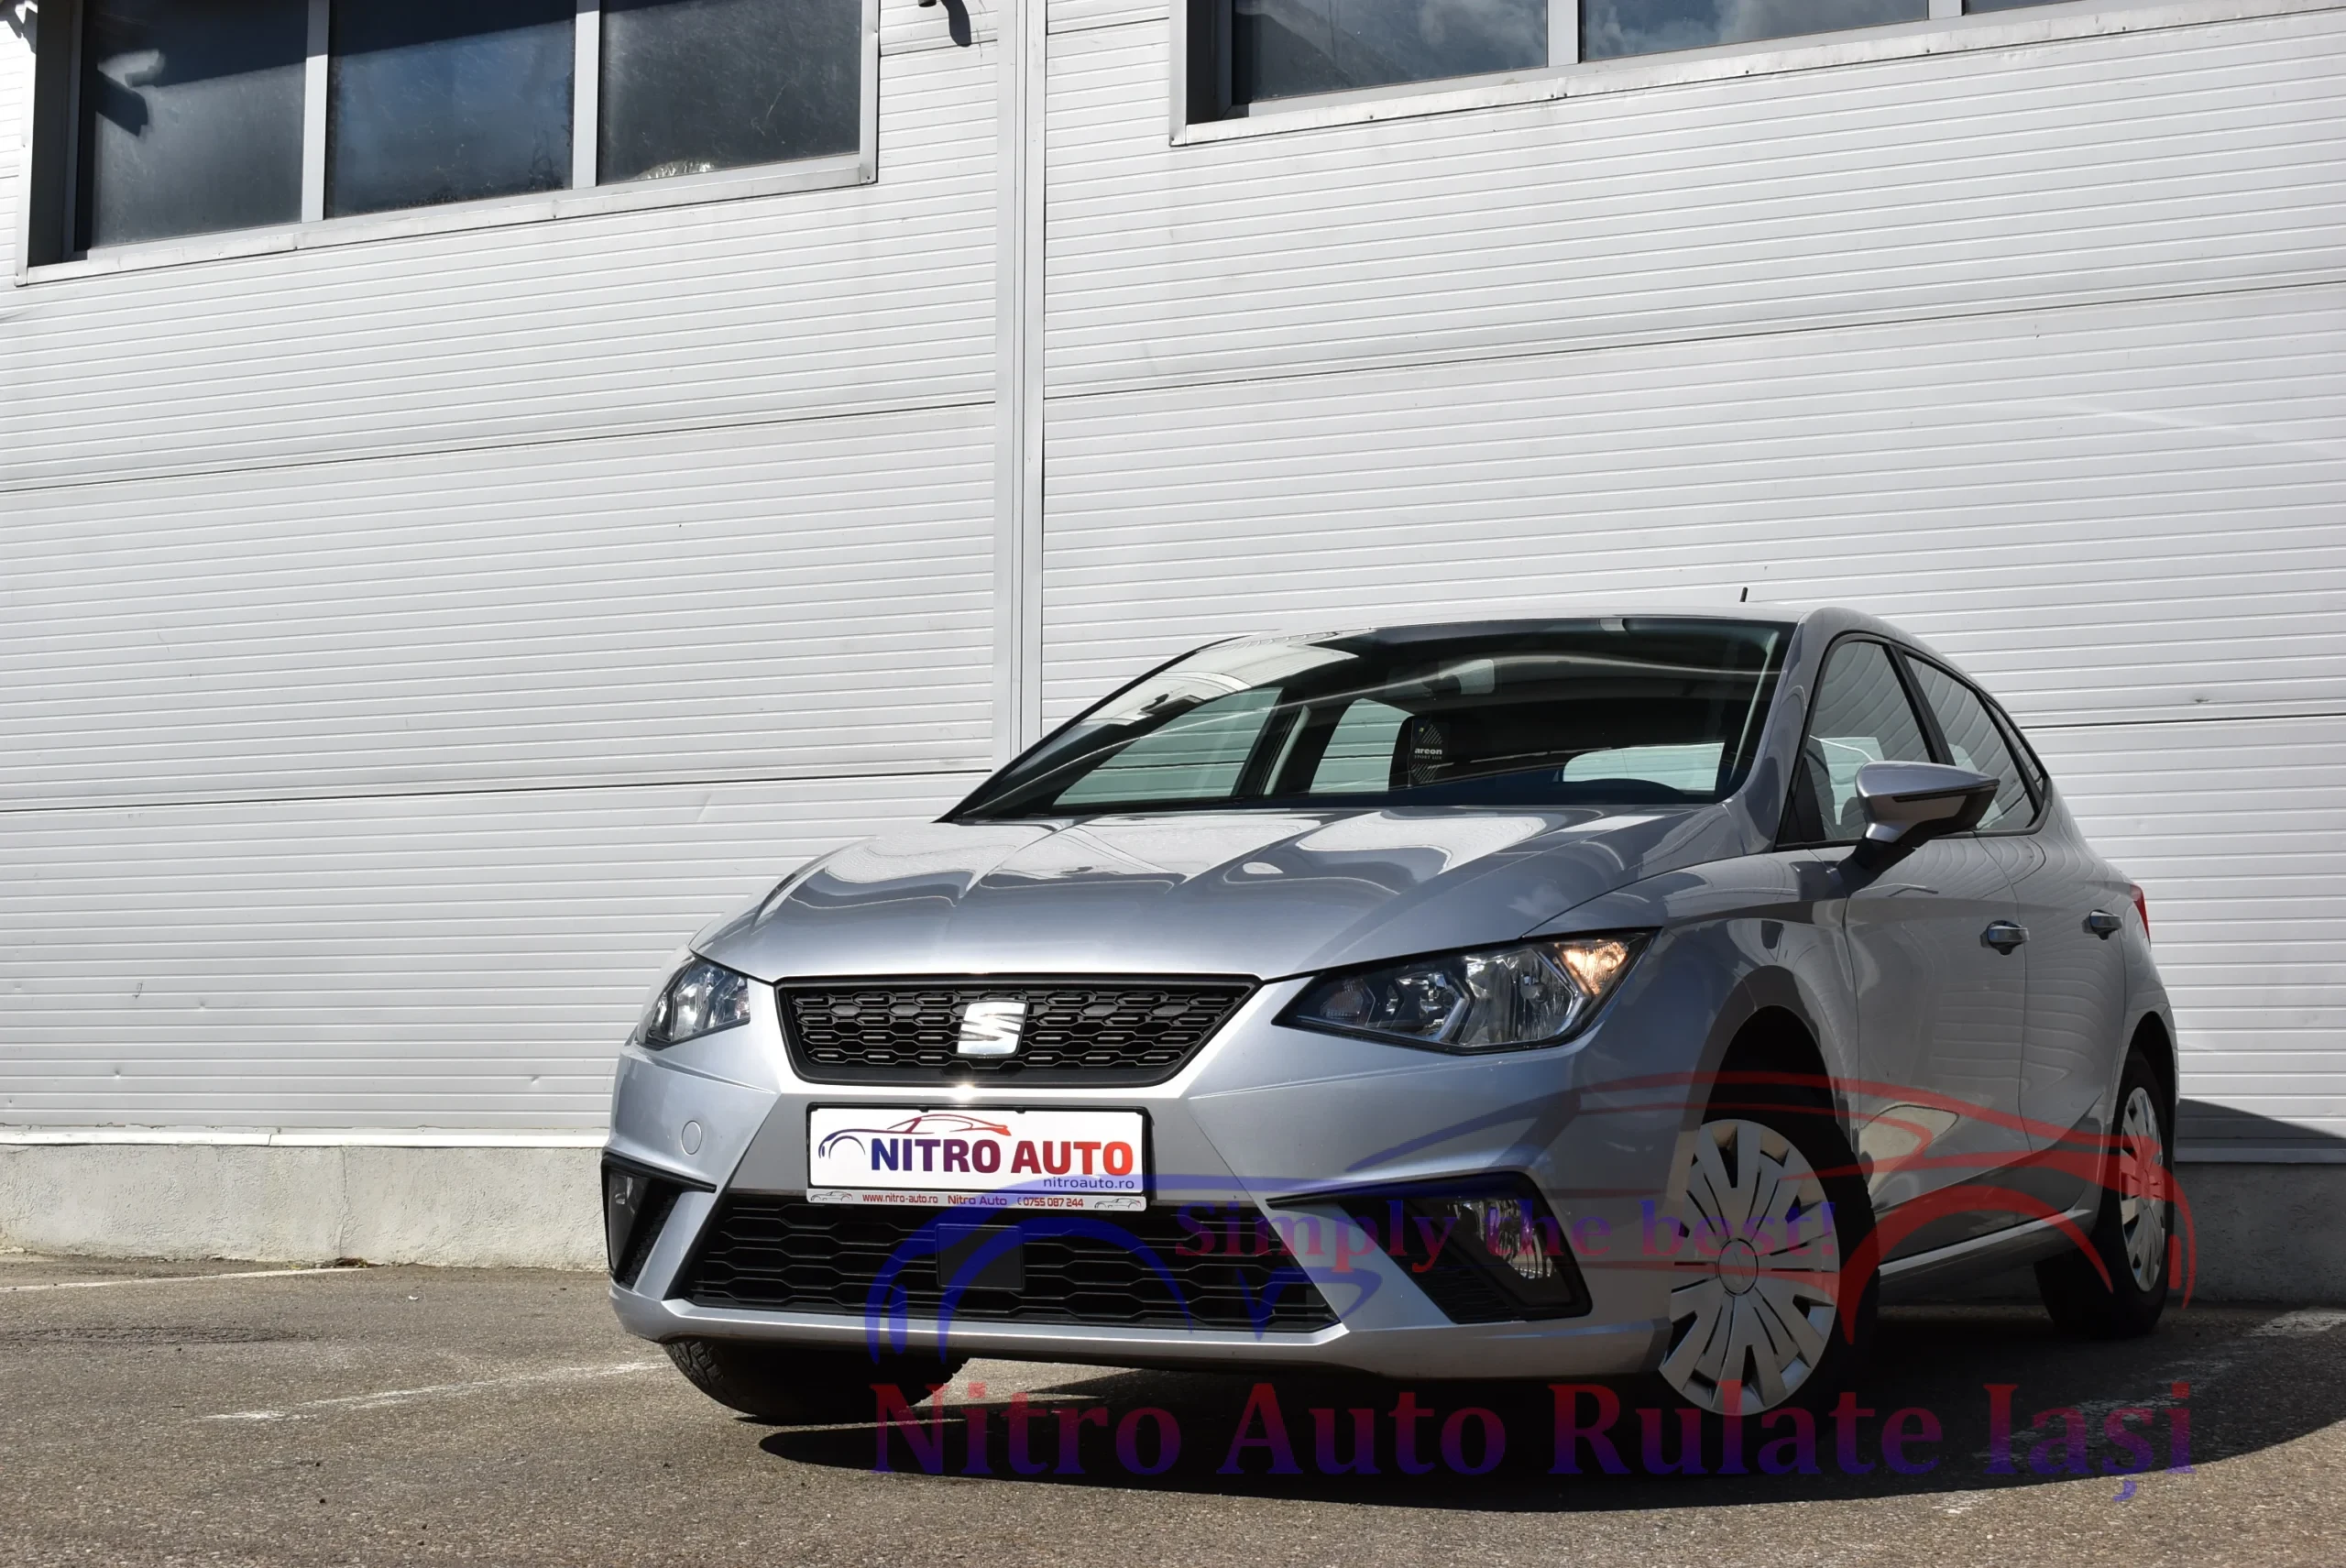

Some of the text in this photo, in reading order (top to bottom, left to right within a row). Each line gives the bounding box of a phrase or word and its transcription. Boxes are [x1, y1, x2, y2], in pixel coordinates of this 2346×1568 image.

[872, 1137, 1133, 1176] NITRO AUTO
[1043, 1177, 1135, 1190] nitroauto.ro
[862, 1193, 1084, 1208] www.nitro-auto.ro Nitro Auto 0755 087 244
